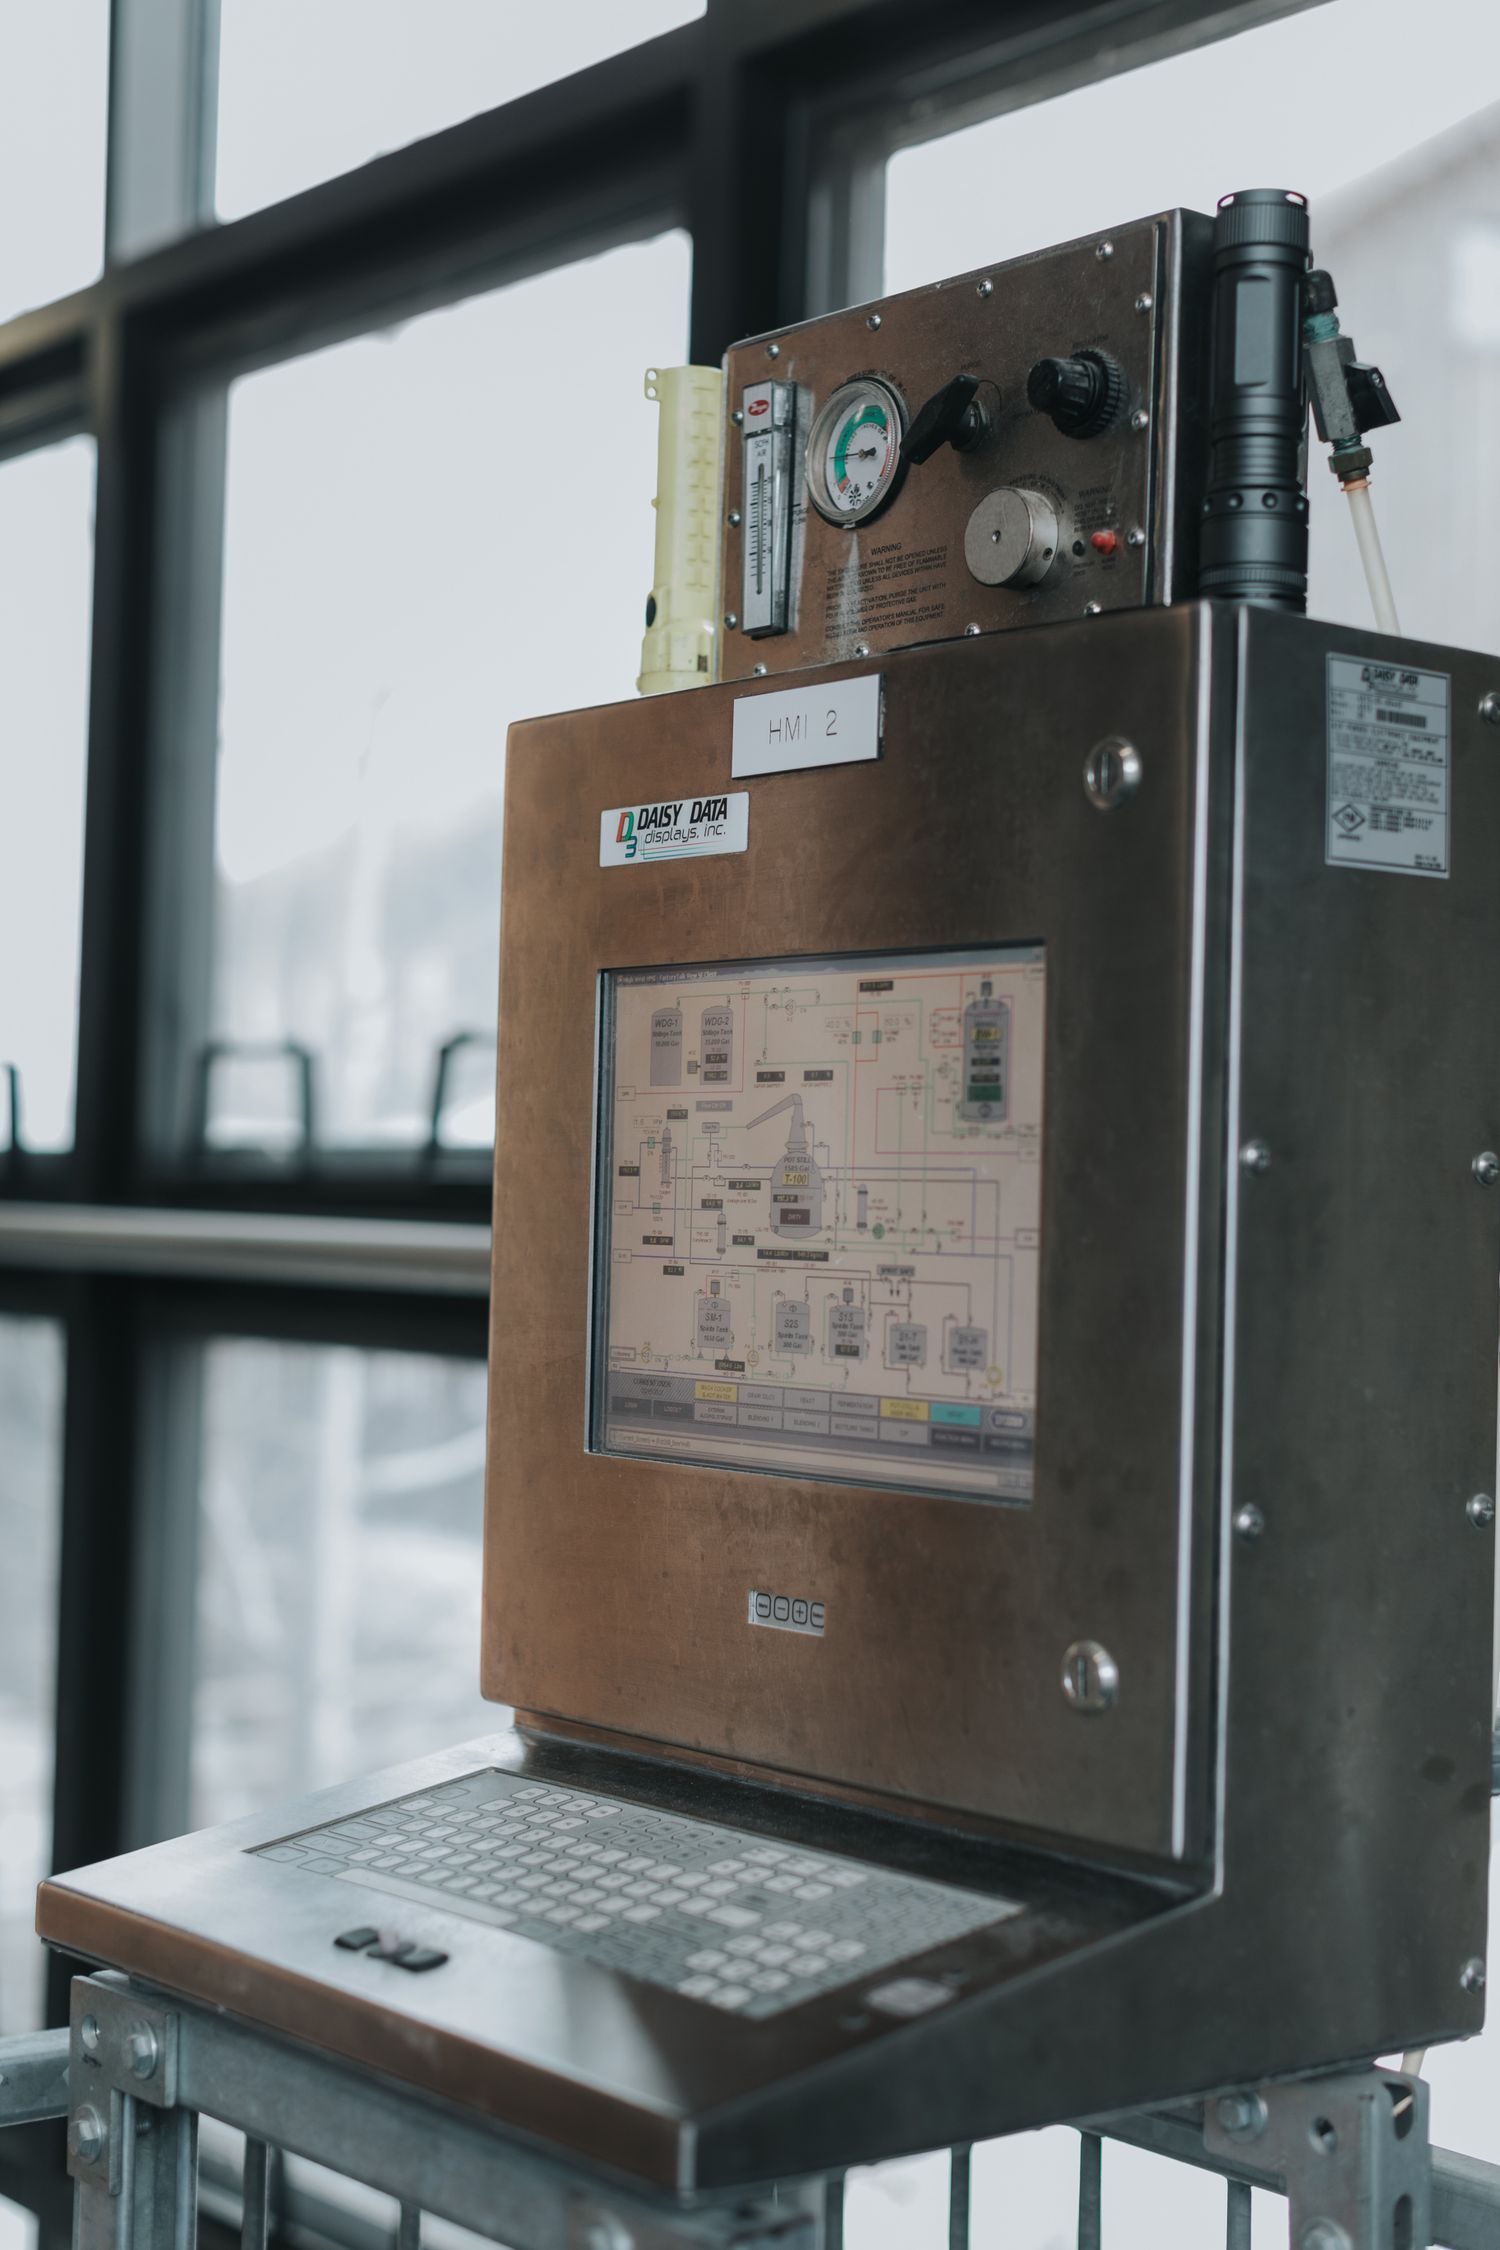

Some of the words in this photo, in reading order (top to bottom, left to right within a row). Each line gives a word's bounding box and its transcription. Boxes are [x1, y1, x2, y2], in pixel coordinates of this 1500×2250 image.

[871, 542, 902, 556] WARNING
[905, 551, 926, 560] OPENED
[926, 545, 948, 554] UNLESS
[862, 575, 882, 584] UNLESS
[882, 572, 891, 580] ALL
[892, 568, 914, 578] DEVICES
[878, 566, 885, 574] TO
[889, 590, 907, 600] PURGE
[908, 588, 917, 596] THE
[875, 599, 905, 610] PROTECTIVE
[896, 609, 916, 619] MANUAL
[918, 606, 930, 614] FOR
[931, 603, 945, 611] SAFE
[868, 620, 895, 632] OPERATION
[904, 616, 914, 624] THIS
[769, 713, 808, 744] HMI
[826, 709, 838, 736] 2
[637, 803, 682, 831] DAISY
[690, 797, 728, 824] DATA
[645, 827, 700, 844] displays,
[704, 823, 726, 837] inc.
[655, 1018, 678, 1028] WDG-1
[704, 1016, 730, 1026] WDG-2
[785, 1174, 806, 1184] T-100
[784, 1319, 799, 1328] S2S
[838, 1312, 854, 1322] S1S
